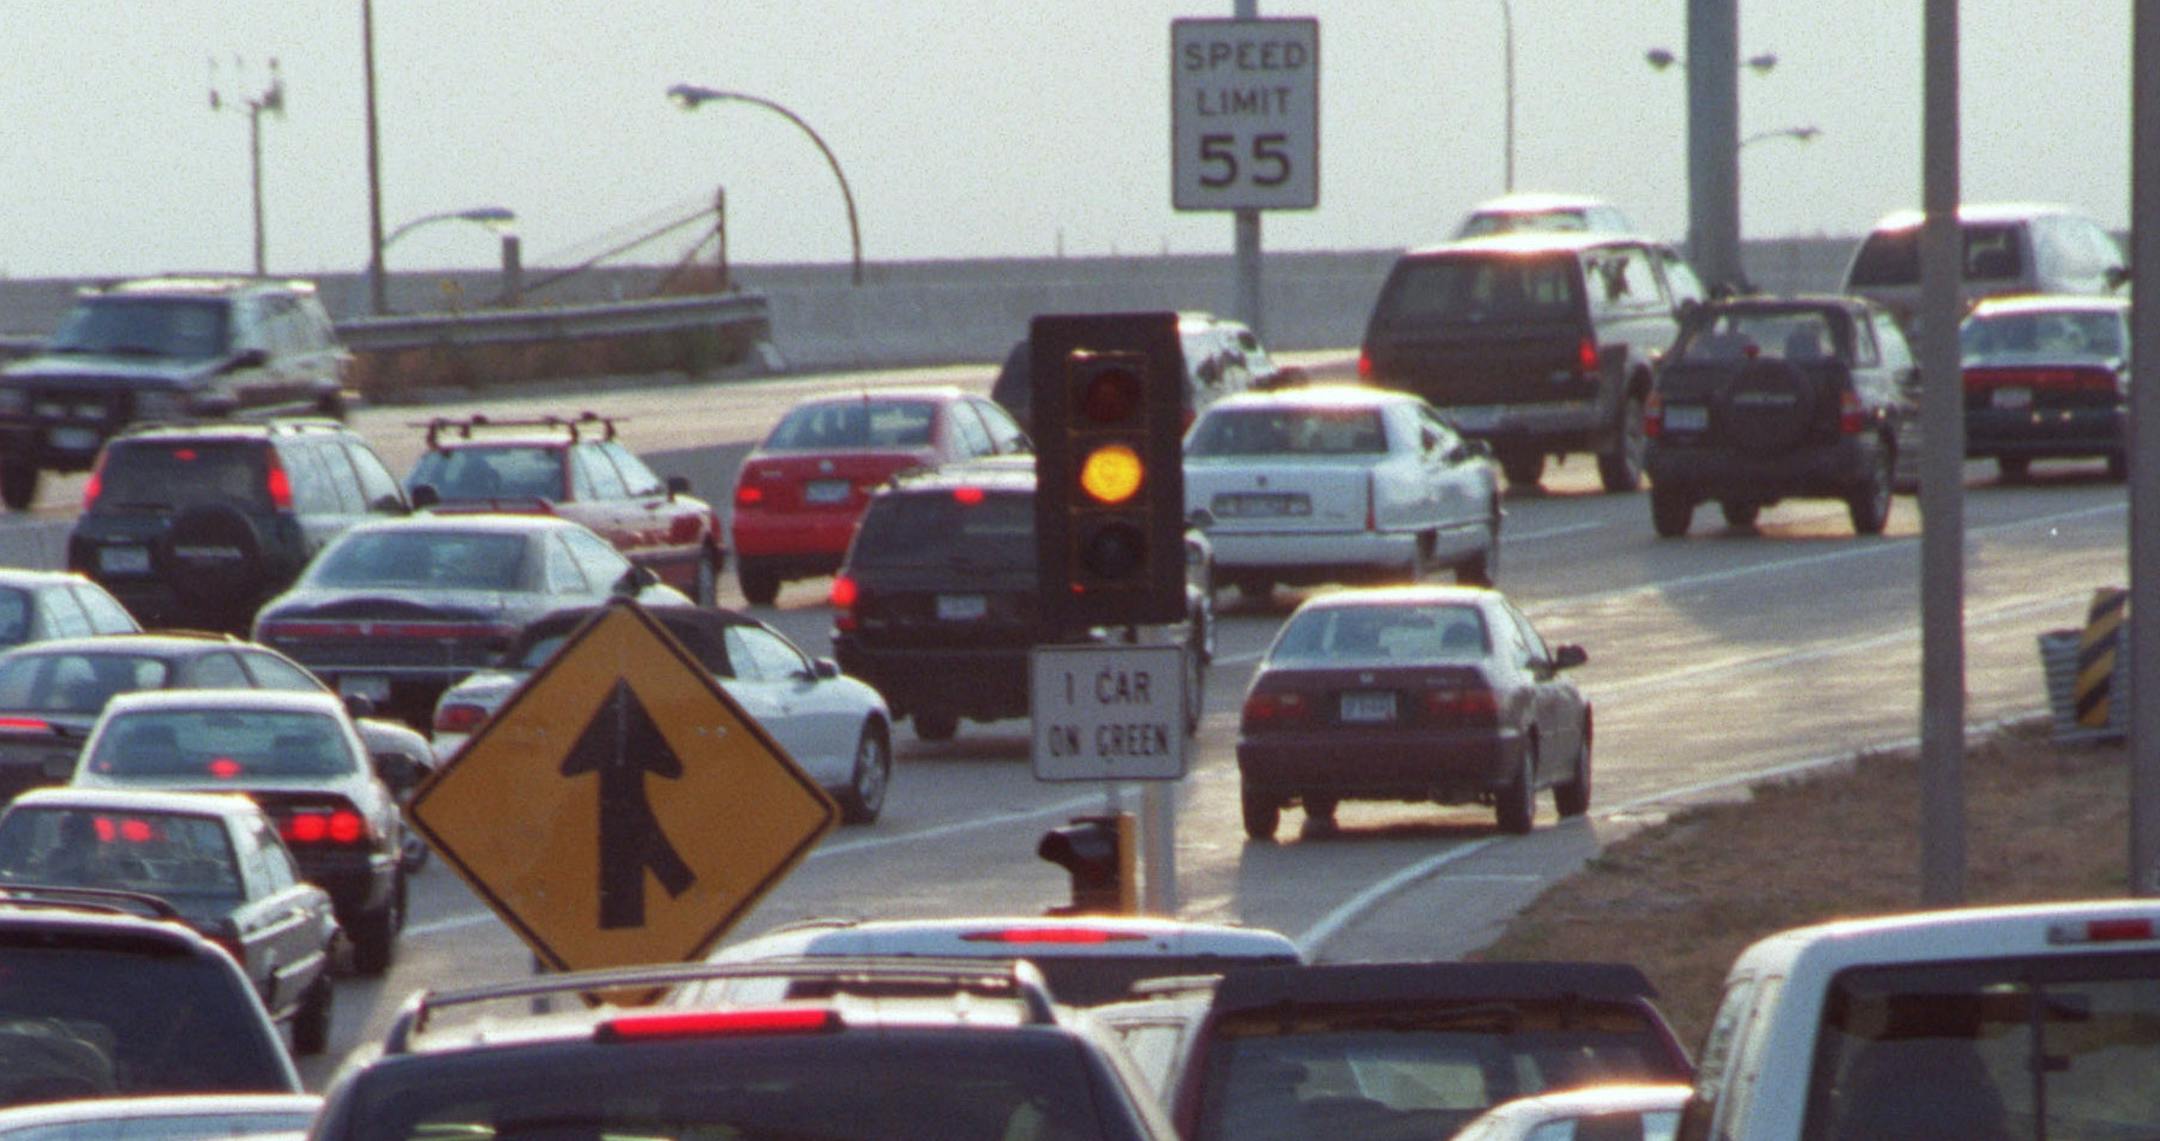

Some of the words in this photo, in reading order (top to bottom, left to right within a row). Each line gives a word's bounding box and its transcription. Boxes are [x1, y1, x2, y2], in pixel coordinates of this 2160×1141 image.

[1183, 41, 1308, 71] SPEED
[1197, 86, 1290, 117] LIMIT
[1201, 133, 1291, 187] 55
[1065, 671, 1074, 705] 1
[1096, 669, 1149, 704] CAR
[1049, 724, 1080, 757] ON
[1096, 723, 1169, 756] GREEN
